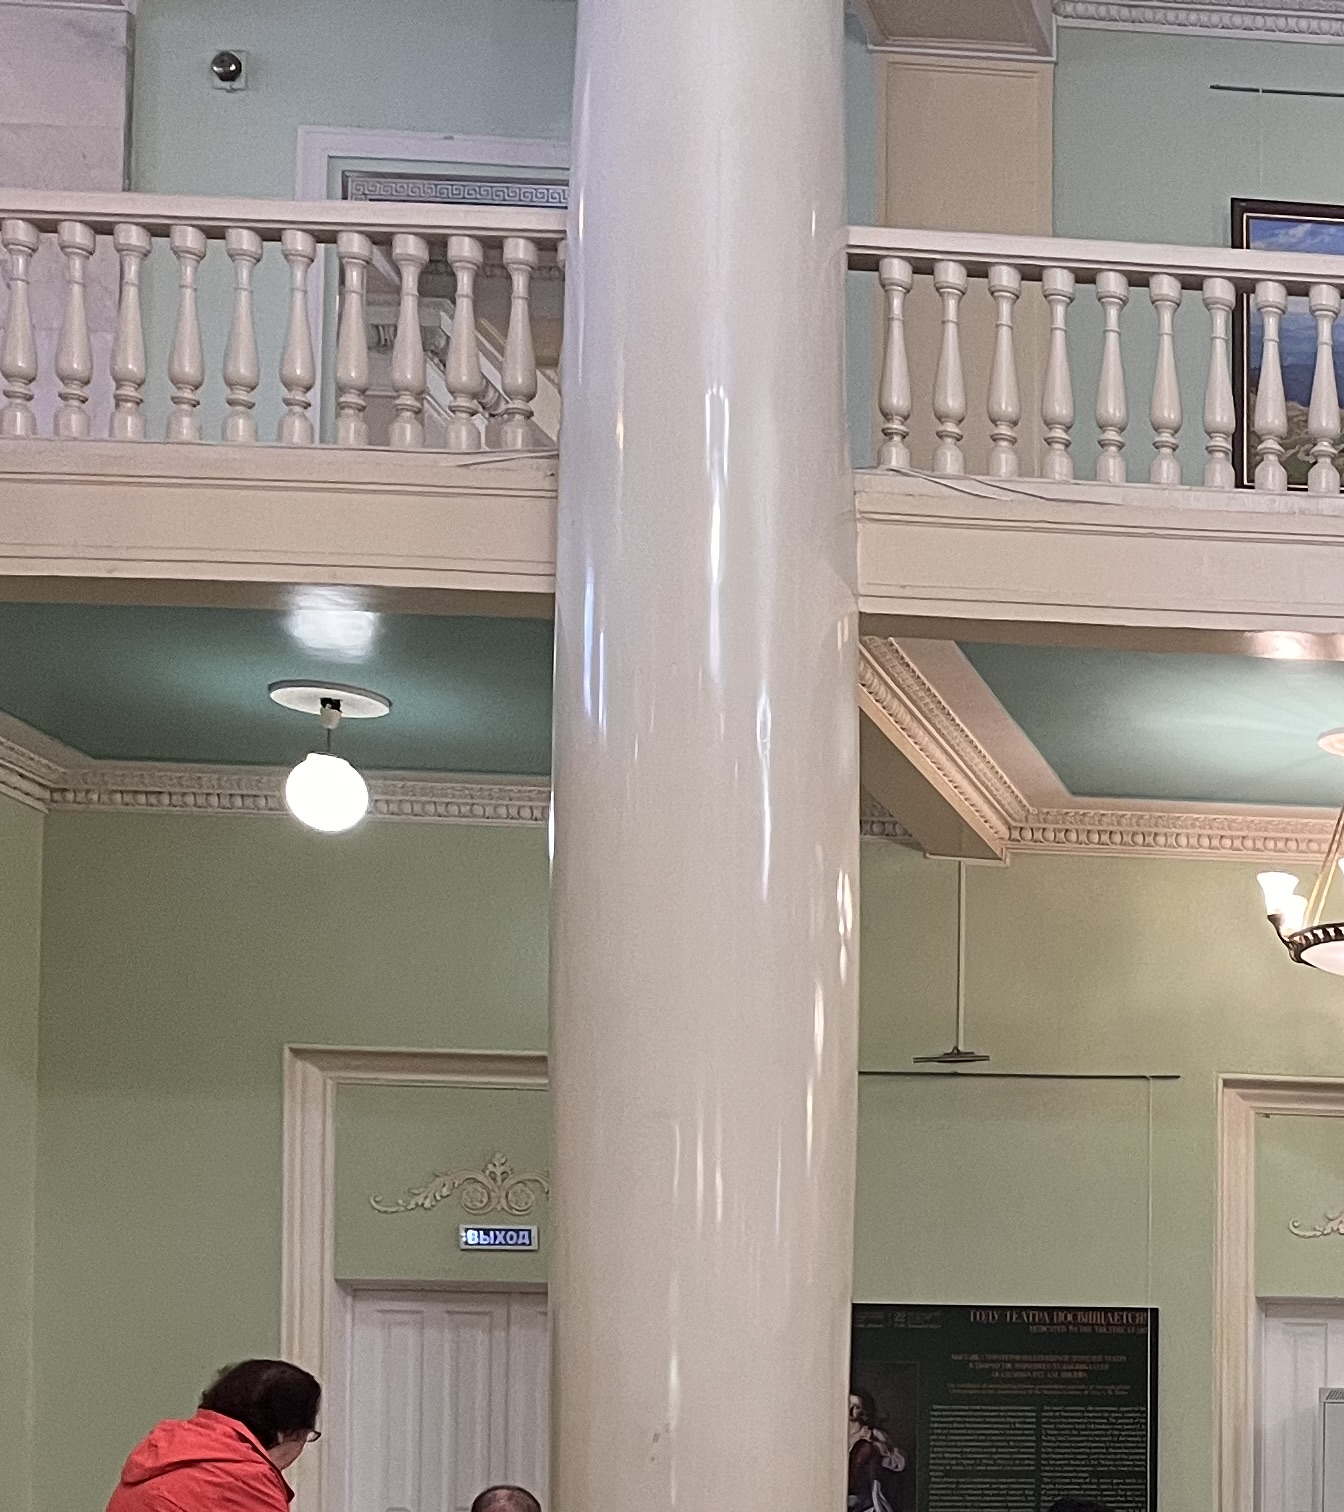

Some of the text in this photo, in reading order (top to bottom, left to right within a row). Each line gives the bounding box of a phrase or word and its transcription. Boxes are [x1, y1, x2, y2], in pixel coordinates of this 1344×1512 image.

[466, 1229, 530, 1245] ВЫХОД
[970, 1309, 998, 1323] ГОДУ
[1006, 1310, 1050, 1324] ТЕАТРА
